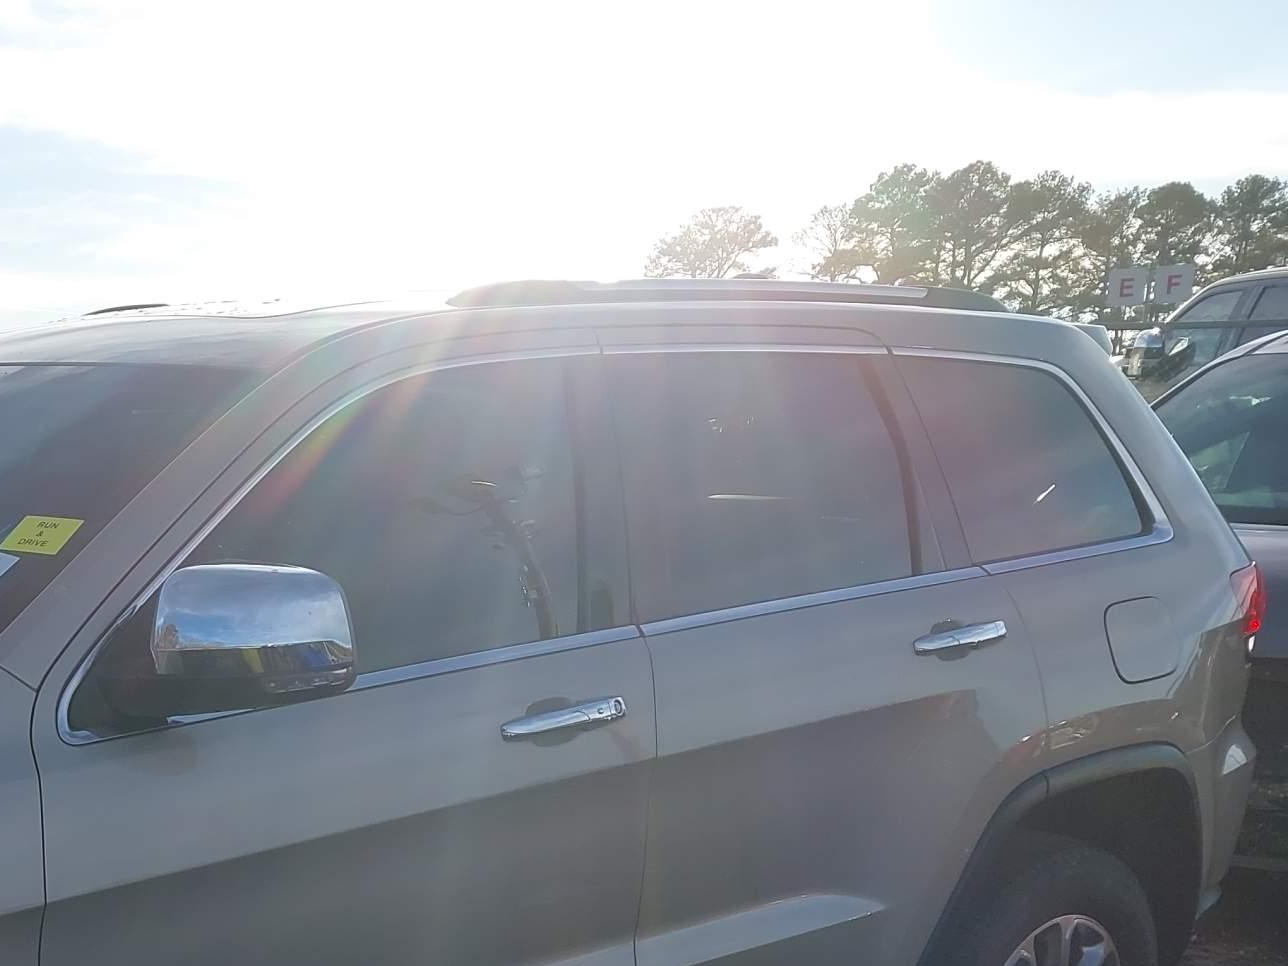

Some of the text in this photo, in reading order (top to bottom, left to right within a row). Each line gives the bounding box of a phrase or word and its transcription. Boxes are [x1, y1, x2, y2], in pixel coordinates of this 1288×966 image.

[1119, 278, 1135, 297] E
[1167, 274, 1183, 295] F
[37, 521, 60, 529] RUN
[17, 537, 49, 547] DRIVE
